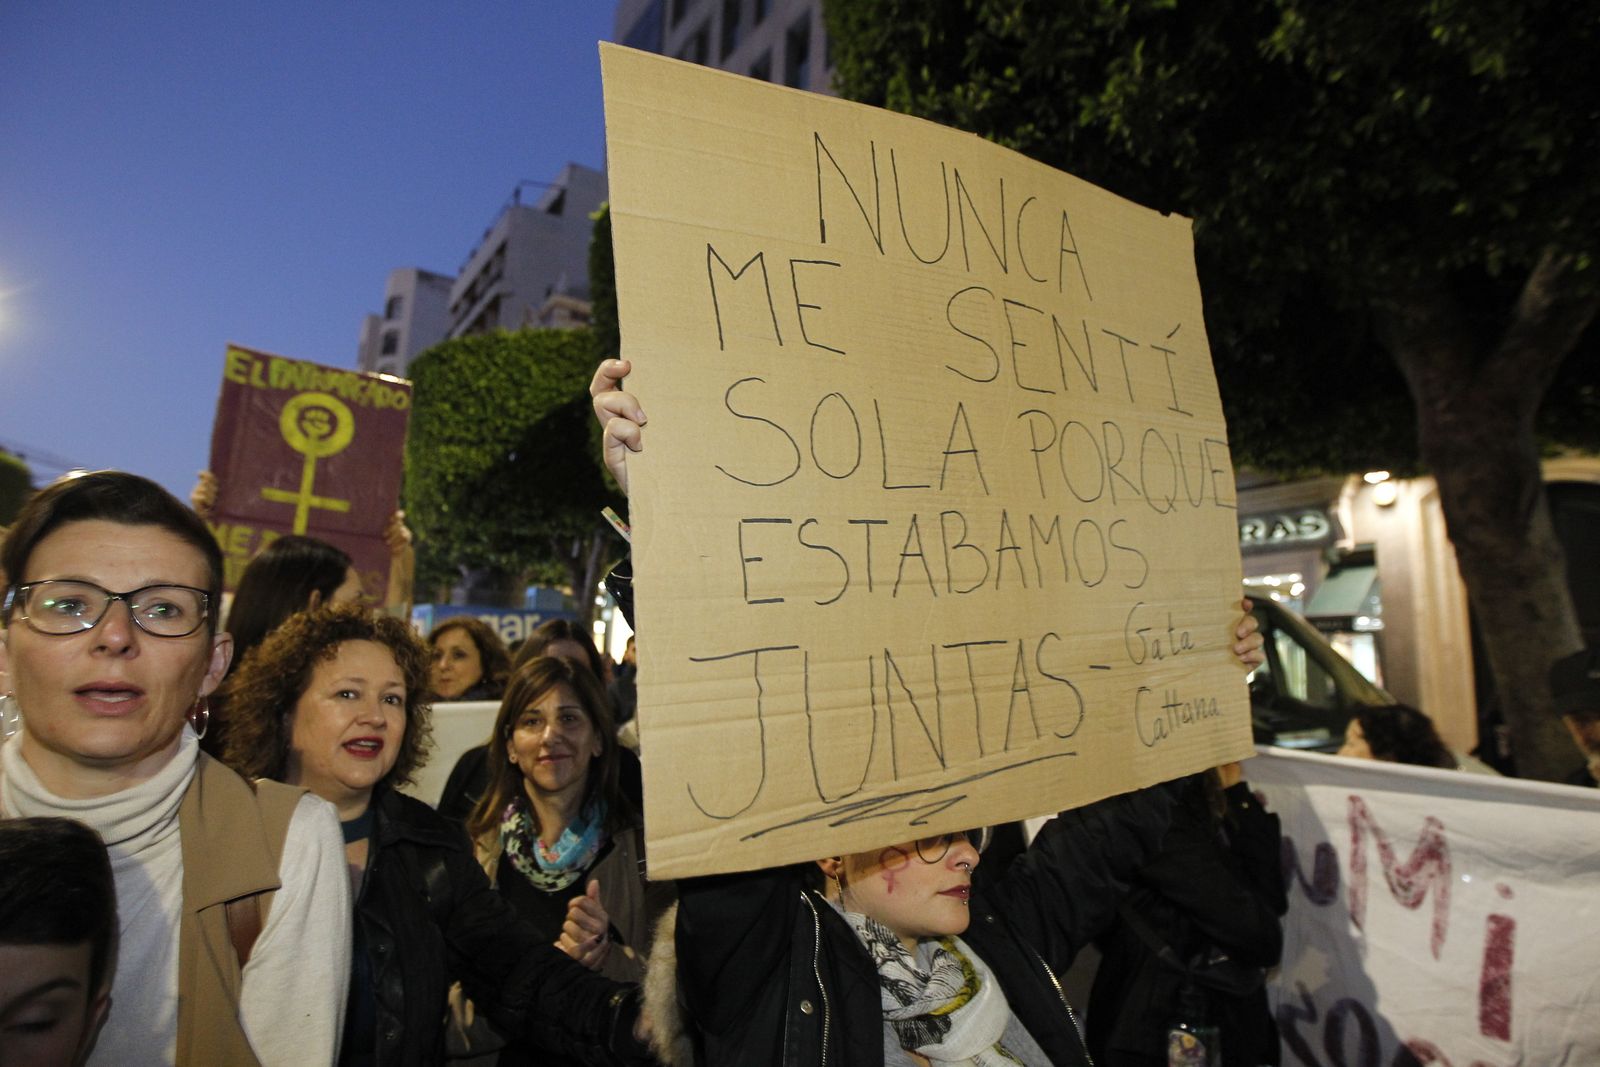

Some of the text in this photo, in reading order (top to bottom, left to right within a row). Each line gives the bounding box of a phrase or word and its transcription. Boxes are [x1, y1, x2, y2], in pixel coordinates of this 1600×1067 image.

[813, 131, 1093, 301] NUNCA
[707, 243, 1194, 417] ME SENTÍ
[714, 376, 1238, 514] SOLA PORQUE
[738, 508, 1150, 606] ESTABAMOS
[686, 632, 1085, 820] JUNTAS
[1124, 601, 1195, 666] Gata
[1134, 685, 1221, 748] Cattana
